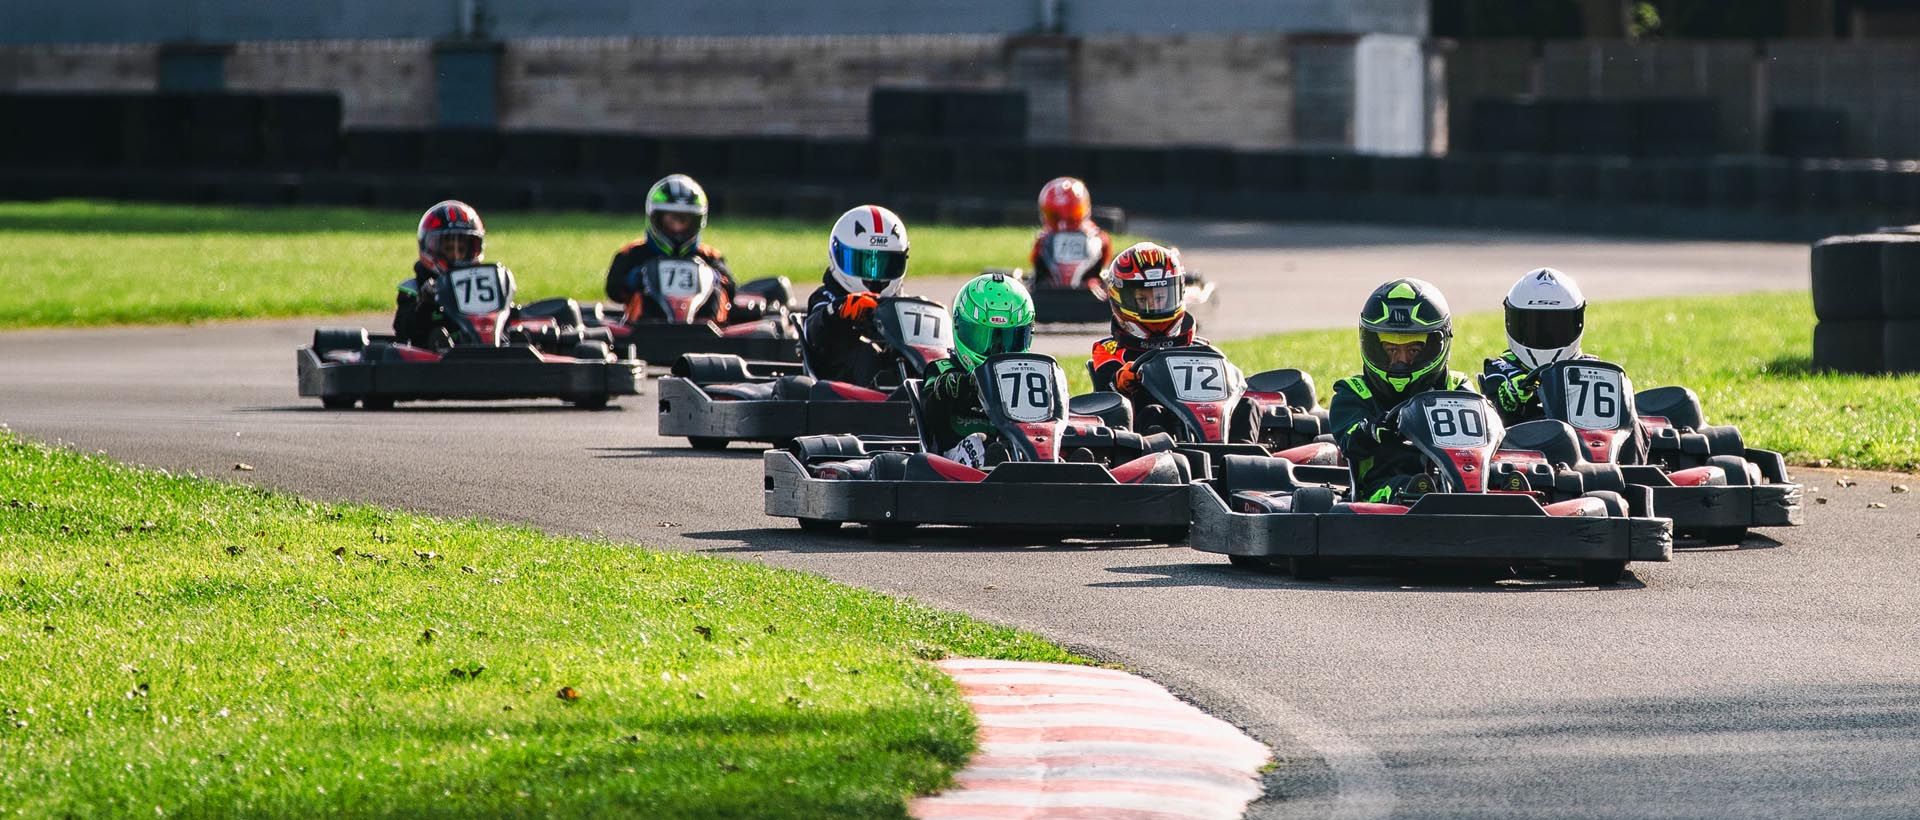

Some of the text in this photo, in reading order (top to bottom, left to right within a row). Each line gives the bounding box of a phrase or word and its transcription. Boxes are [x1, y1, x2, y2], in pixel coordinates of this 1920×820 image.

[869, 237, 889, 245] OMP
[455, 276, 495, 305] 75
[662, 267, 693, 289] 73
[903, 311, 941, 339] 77
[1001, 372, 1050, 409] 78
[1173, 365, 1222, 391] 72
[1568, 379, 1615, 418] 76
[1430, 408, 1484, 438] 80
